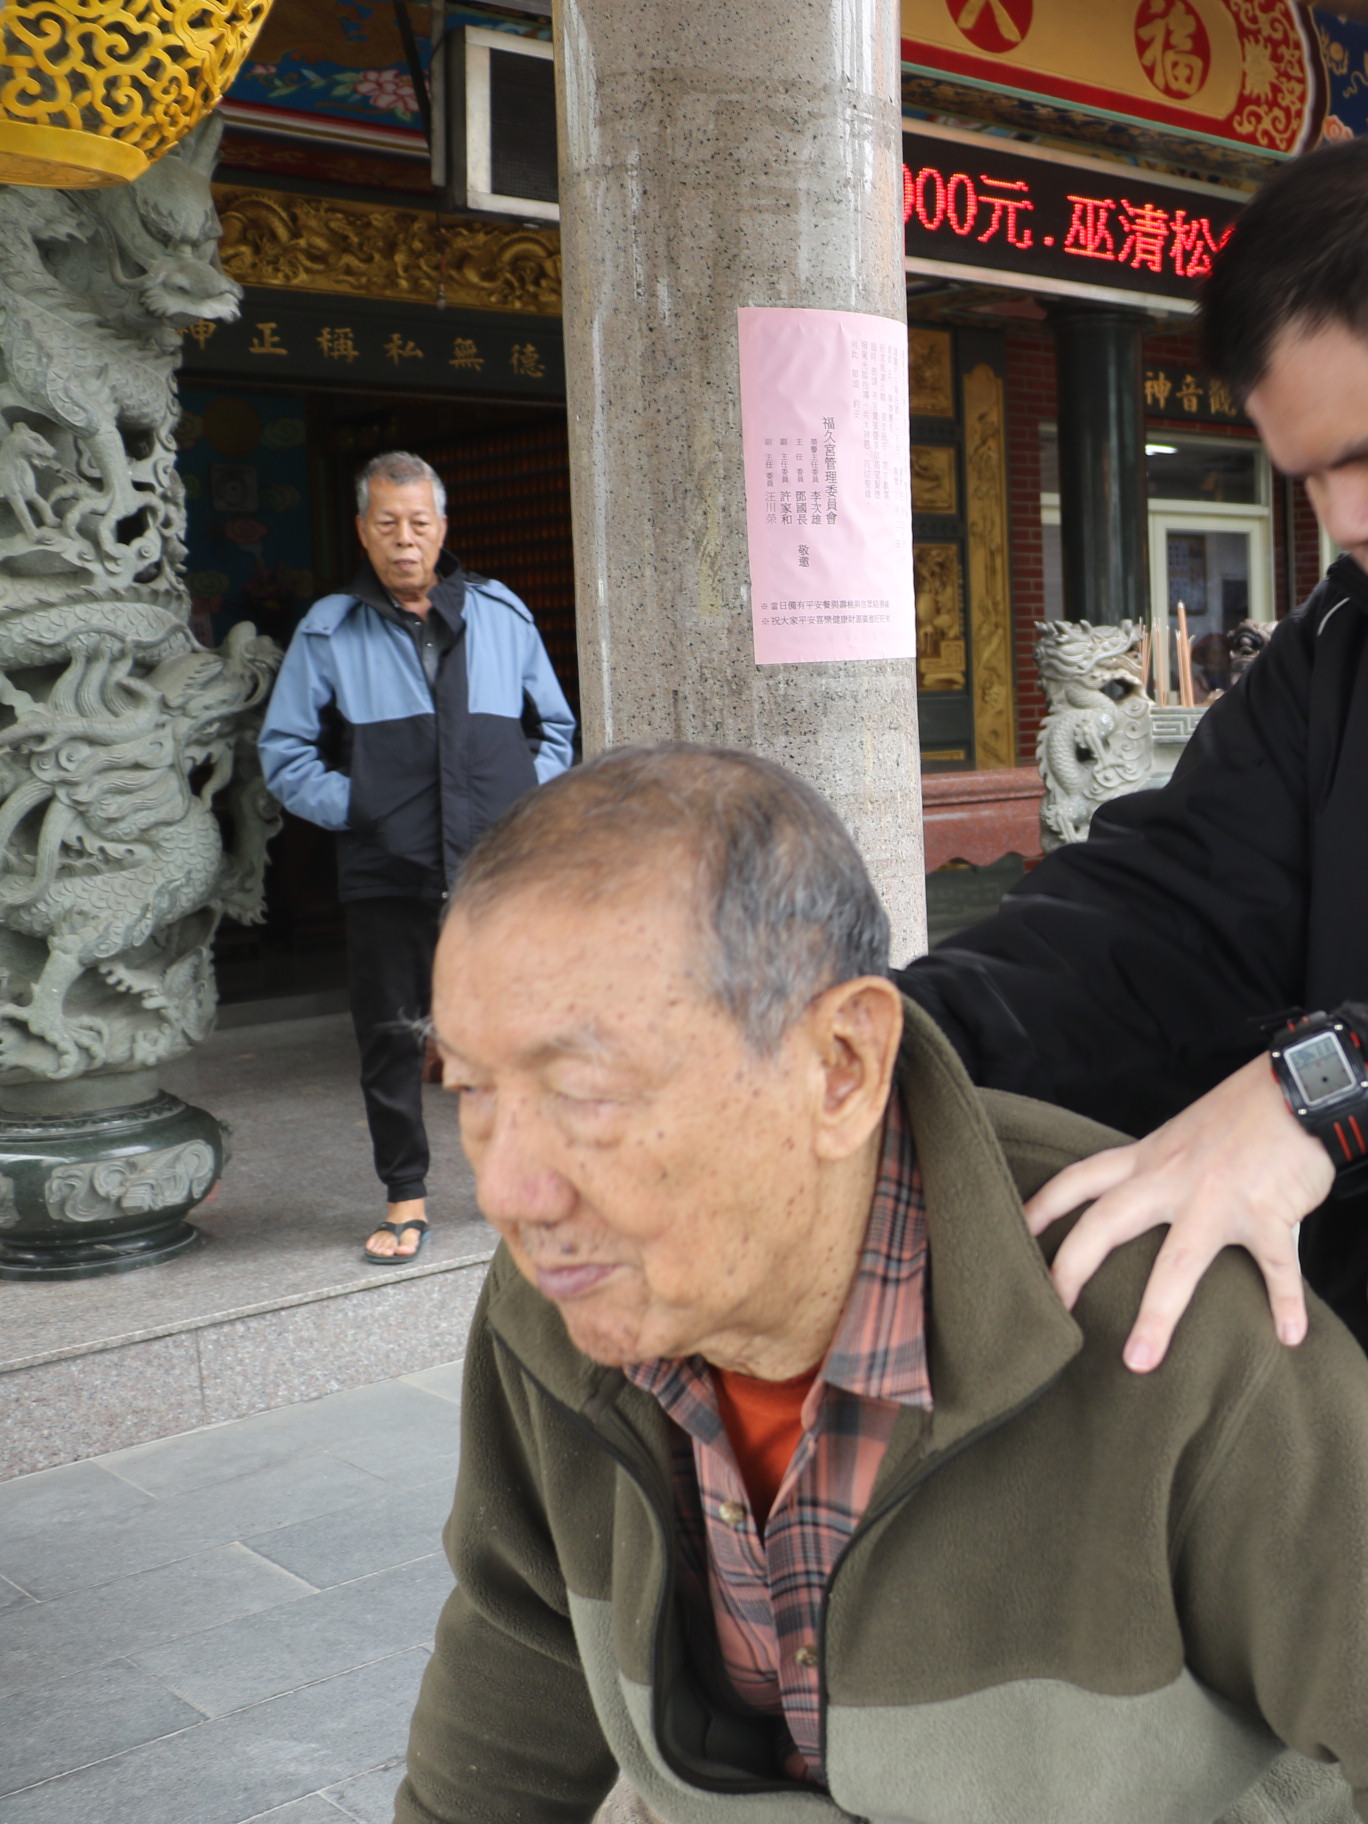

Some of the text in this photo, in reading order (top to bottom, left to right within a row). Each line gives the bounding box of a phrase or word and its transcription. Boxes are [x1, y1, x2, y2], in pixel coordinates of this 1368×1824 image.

[822, 415, 838, 526] 福久宮管理委員會
[780, 490, 793, 526] 許家和
[810, 490, 822, 525] 李次雄
[798, 544, 810, 568] 敬邀
